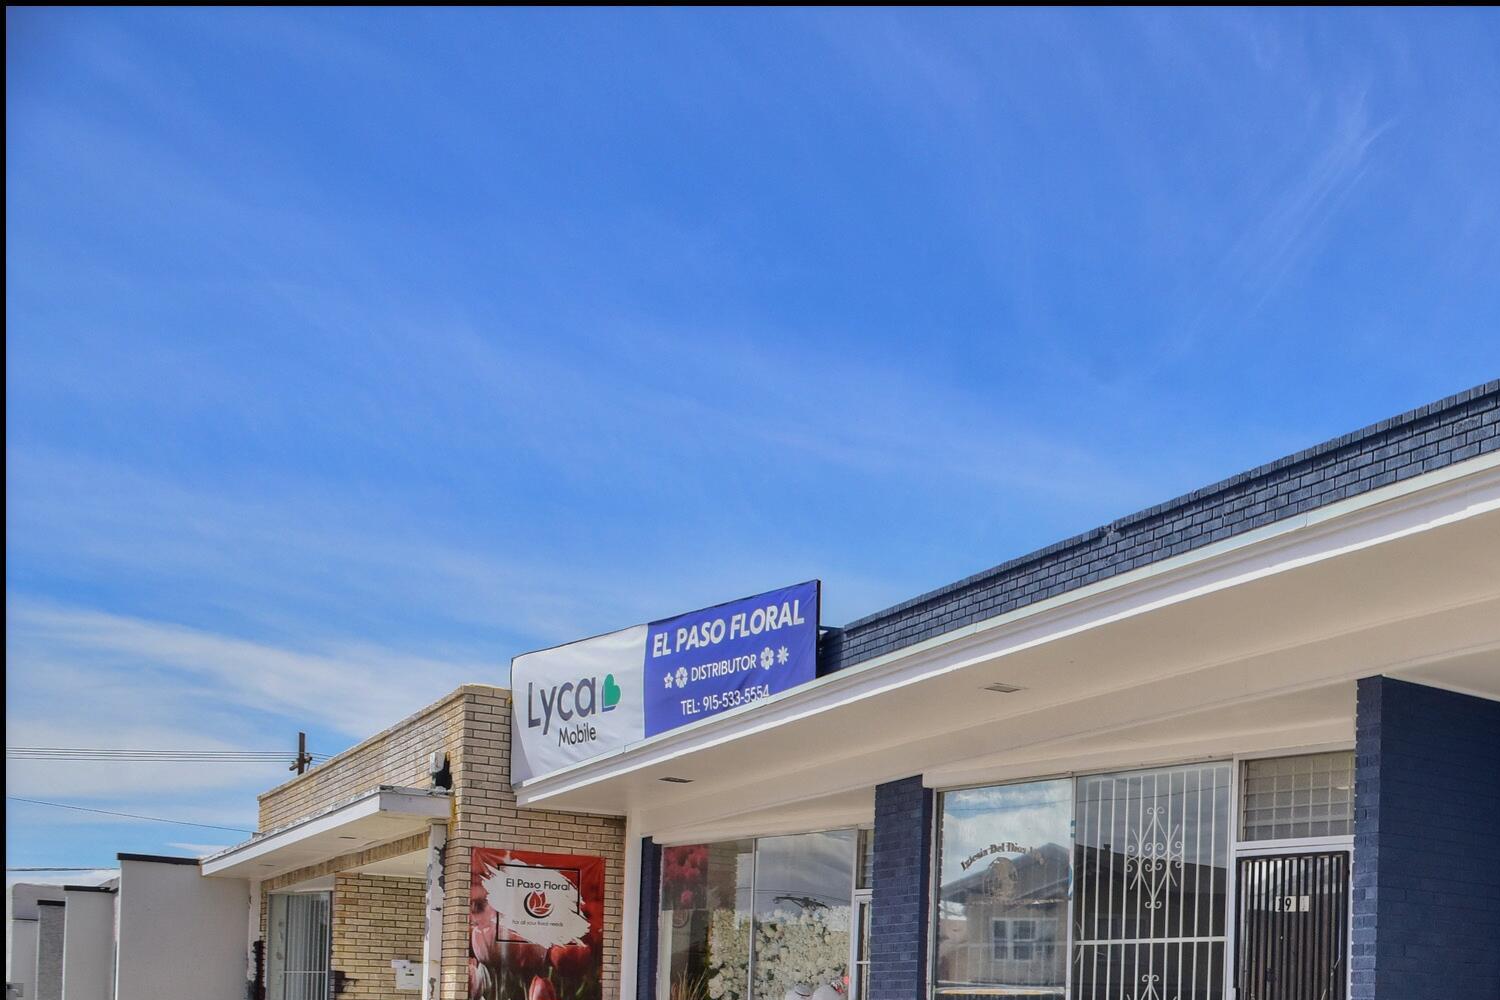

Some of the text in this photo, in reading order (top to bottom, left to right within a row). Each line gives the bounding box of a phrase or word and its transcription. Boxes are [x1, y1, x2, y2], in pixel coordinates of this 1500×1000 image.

[652, 599, 805, 659] EL PASO FLORAL
[691, 654, 757, 682] DISTRIBUTOR
[528, 676, 597, 735] Lyca
[681, 684, 770, 716] TEL: 915-533-5554
[558, 724, 597, 747] Mobile
[506, 878, 570, 891] El Paso Floral
